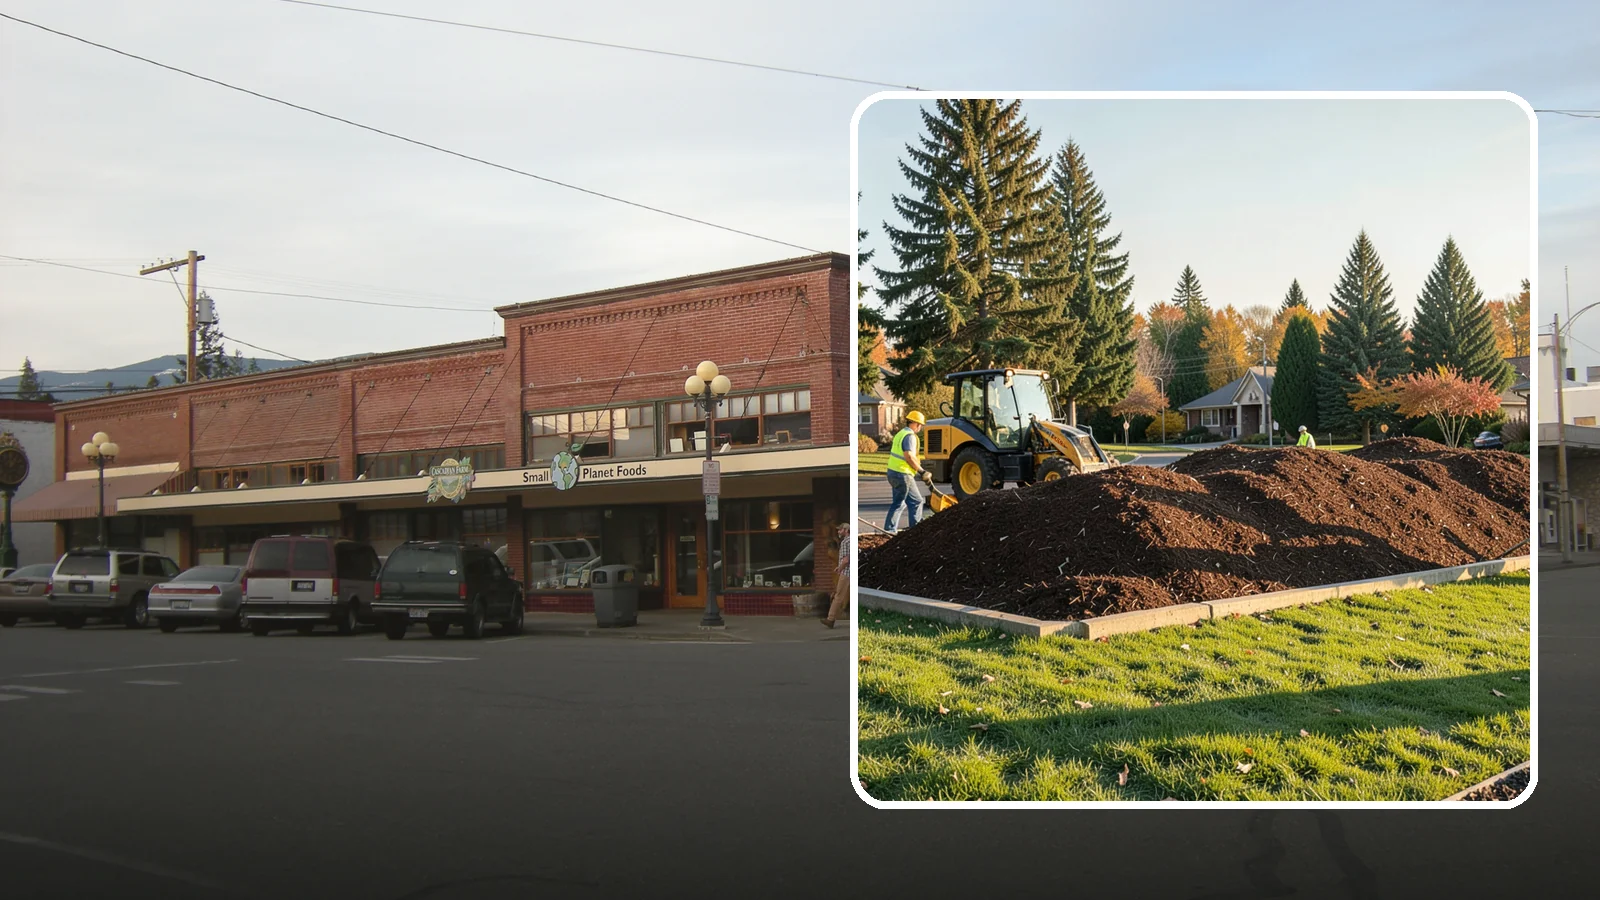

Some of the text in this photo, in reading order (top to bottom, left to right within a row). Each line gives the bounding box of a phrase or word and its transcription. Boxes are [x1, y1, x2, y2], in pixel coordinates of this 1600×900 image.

[523, 464, 647, 482] Small Planet Foods
